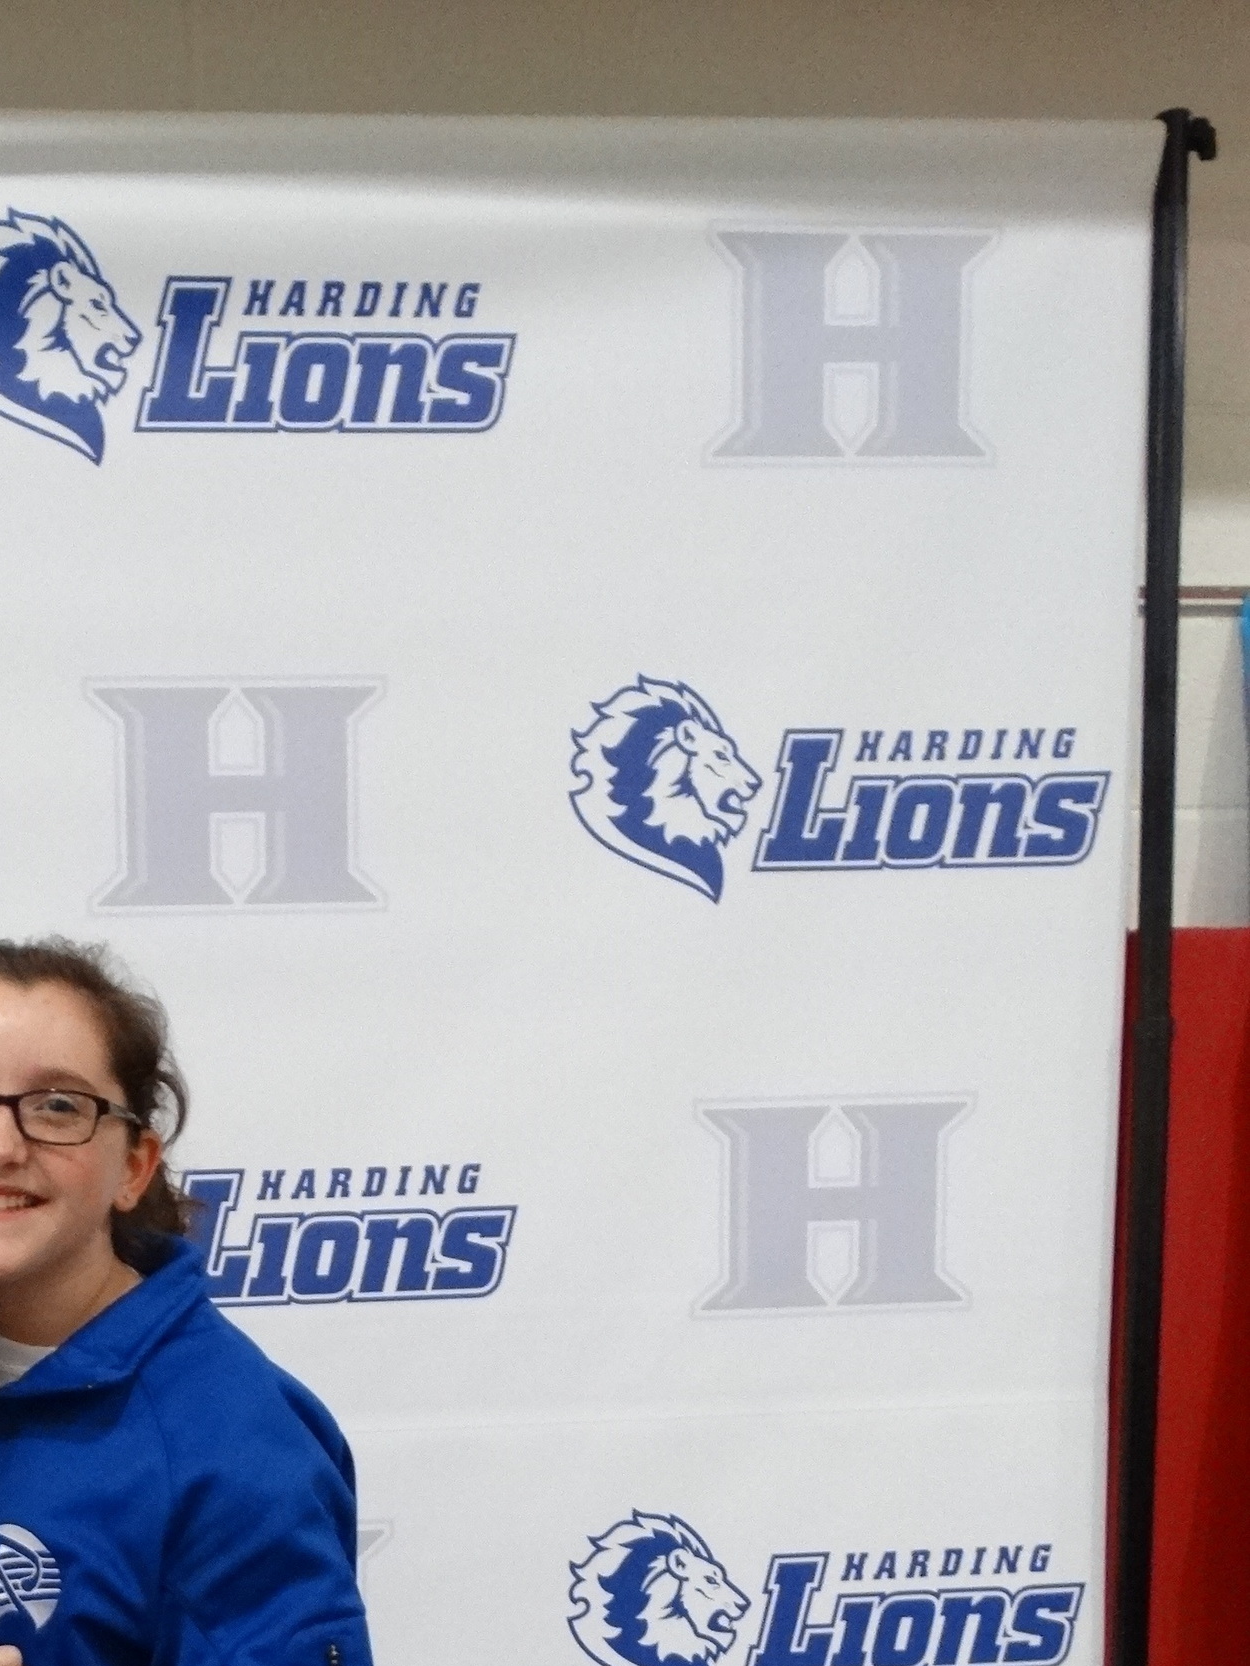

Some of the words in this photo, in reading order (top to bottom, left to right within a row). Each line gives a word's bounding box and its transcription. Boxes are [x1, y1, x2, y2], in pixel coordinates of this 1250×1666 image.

[245, 279, 482, 321] HARDING
[698, 218, 1003, 467] H
[853, 727, 1077, 763] HARDING
[81, 675, 388, 915] H
[257, 1163, 481, 1200] HARDING
[690, 1090, 977, 1321] H
[840, 1543, 1053, 1580] HARDING
